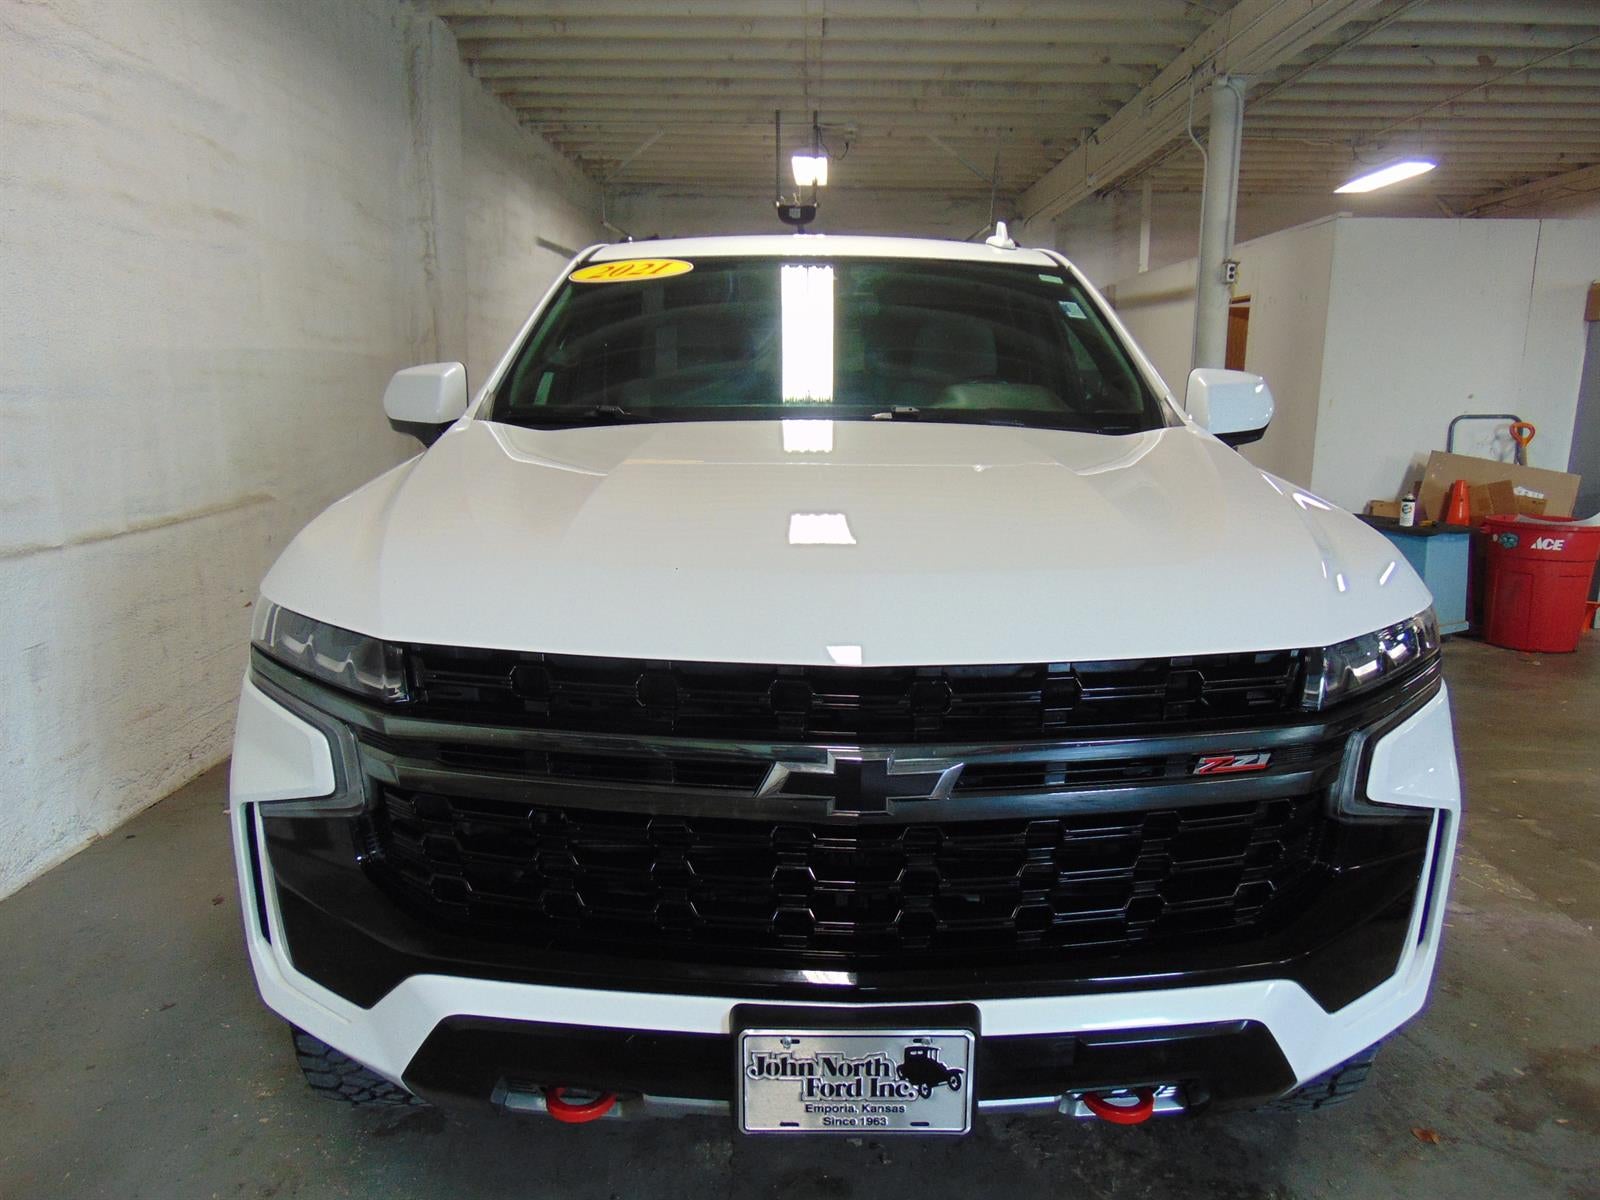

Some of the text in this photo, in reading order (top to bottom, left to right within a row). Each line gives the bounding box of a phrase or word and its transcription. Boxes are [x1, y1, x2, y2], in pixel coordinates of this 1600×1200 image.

[587, 263, 672, 279] 2021
[1531, 537, 1566, 551] ACE
[1193, 753, 1271, 775] Z71
[750, 1055, 890, 1077] John North
[806, 1078, 916, 1099] Ford Inc.
[805, 1104, 905, 1115] Emporia, Kansas
[823, 1117, 887, 1126] Since 1963
